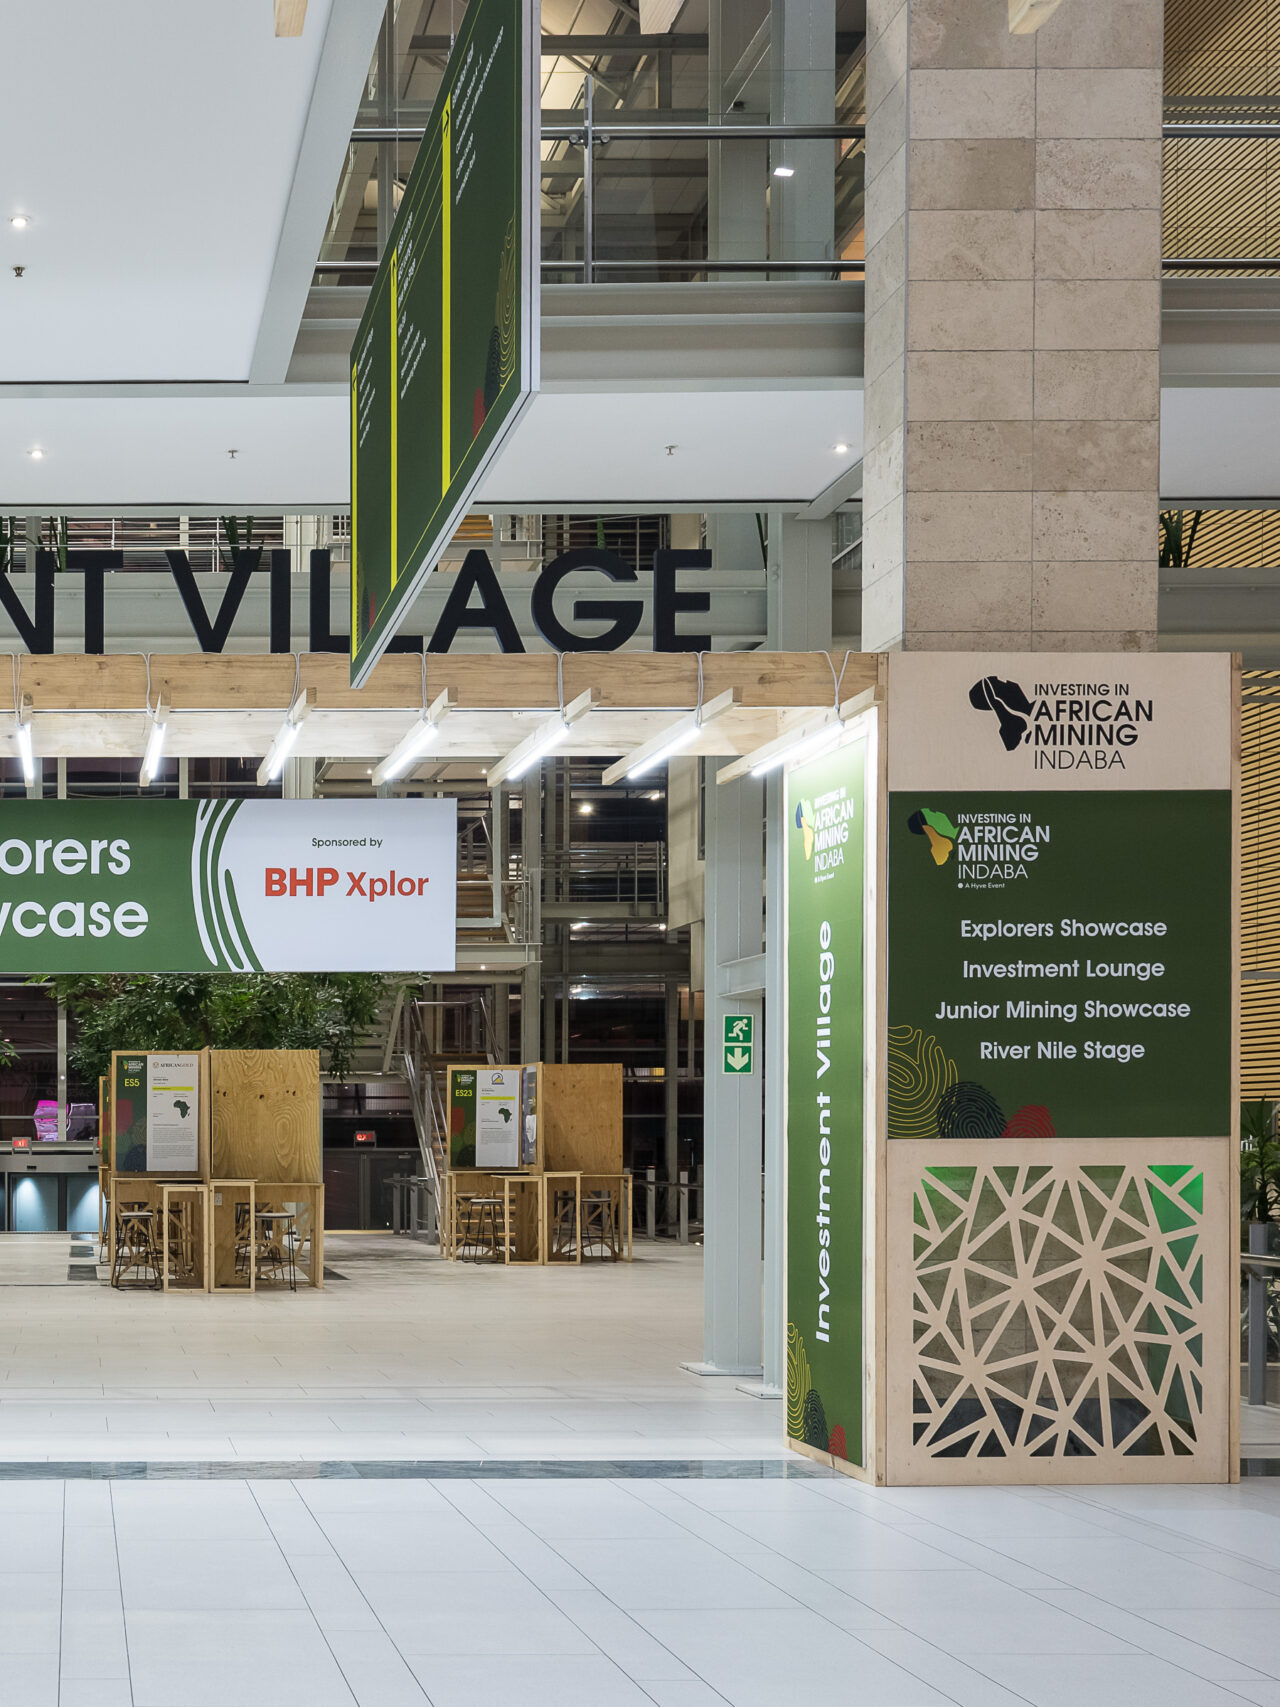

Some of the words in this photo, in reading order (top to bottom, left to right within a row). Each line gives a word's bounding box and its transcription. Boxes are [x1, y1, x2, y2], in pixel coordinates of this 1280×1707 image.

[1034, 683, 1110, 697] INVESTING
[1114, 683, 1129, 696] IN
[1036, 700, 1152, 721] AFRICAN
[1034, 723, 1139, 747] MINING
[1034, 749, 1126, 770] INDABA
[814, 798, 854, 832] AFRICAN
[957, 813, 1017, 824] INVESTING
[1019, 813, 1032, 824] IN
[311, 837, 367, 849] Sponsored
[369, 837, 383, 848] by
[815, 822, 848, 853] MINING
[958, 825, 1050, 843] AFRICAN
[815, 848, 844, 872] INDABA
[958, 843, 1039, 862] MINING
[958, 863, 1029, 880] INDABA
[265, 868, 339, 896] BHP
[346, 870, 429, 902] Xplor
[960, 919, 1054, 941] Explorers
[1060, 918, 1168, 937] Showcase
[963, 959, 1080, 978] Investment
[1086, 959, 1166, 982] Lounge
[817, 920, 834, 1080] Village
[935, 1001, 1000, 1020] Junior
[1006, 1000, 1078, 1023] Mining
[1084, 1000, 1191, 1018] Showcase
[980, 1041, 1031, 1060] River
[1037, 1041, 1078, 1059] Nile
[1083, 1040, 1145, 1063] Stage
[816, 1091, 831, 1343] Investment
